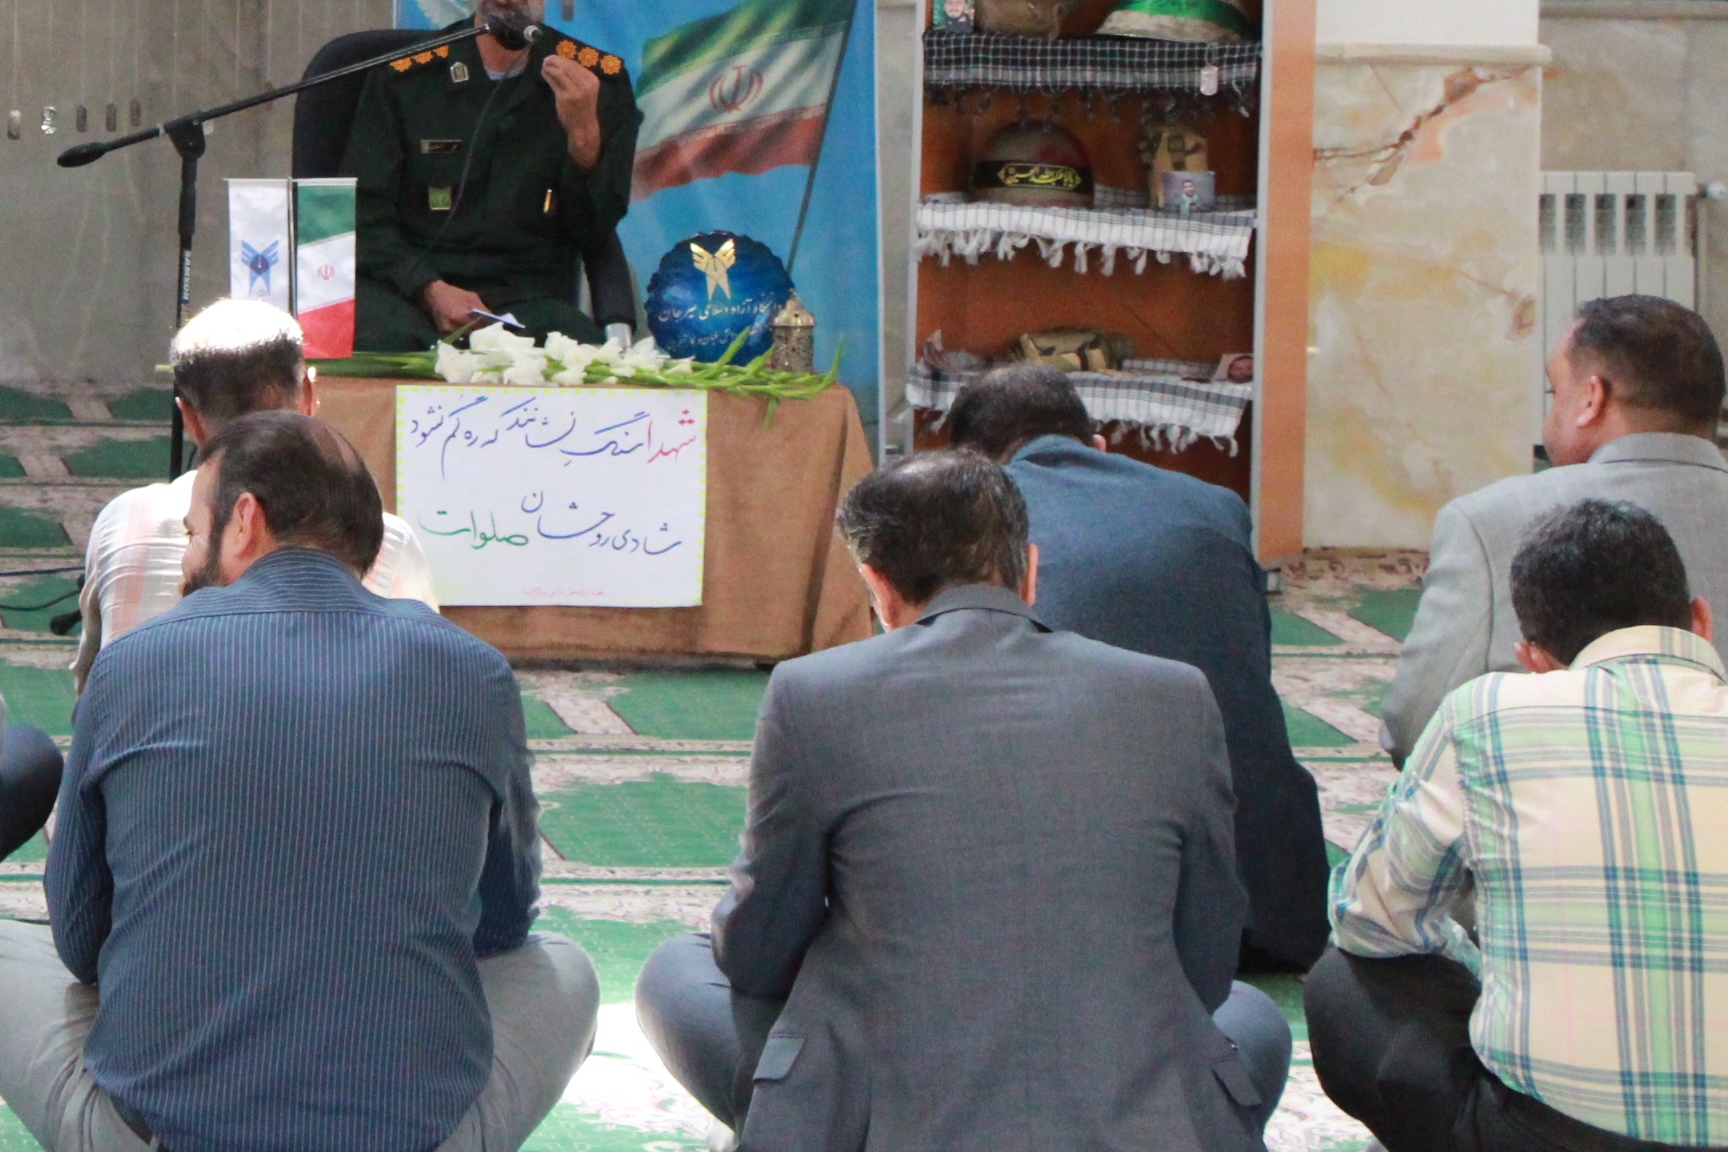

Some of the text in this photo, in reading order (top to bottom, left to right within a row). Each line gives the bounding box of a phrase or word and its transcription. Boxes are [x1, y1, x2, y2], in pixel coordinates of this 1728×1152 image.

[409, 405, 443, 448] نشود
[646, 408, 697, 464] شهدا
[417, 507, 530, 550] صلوات
[611, 522, 682, 555] شادی
